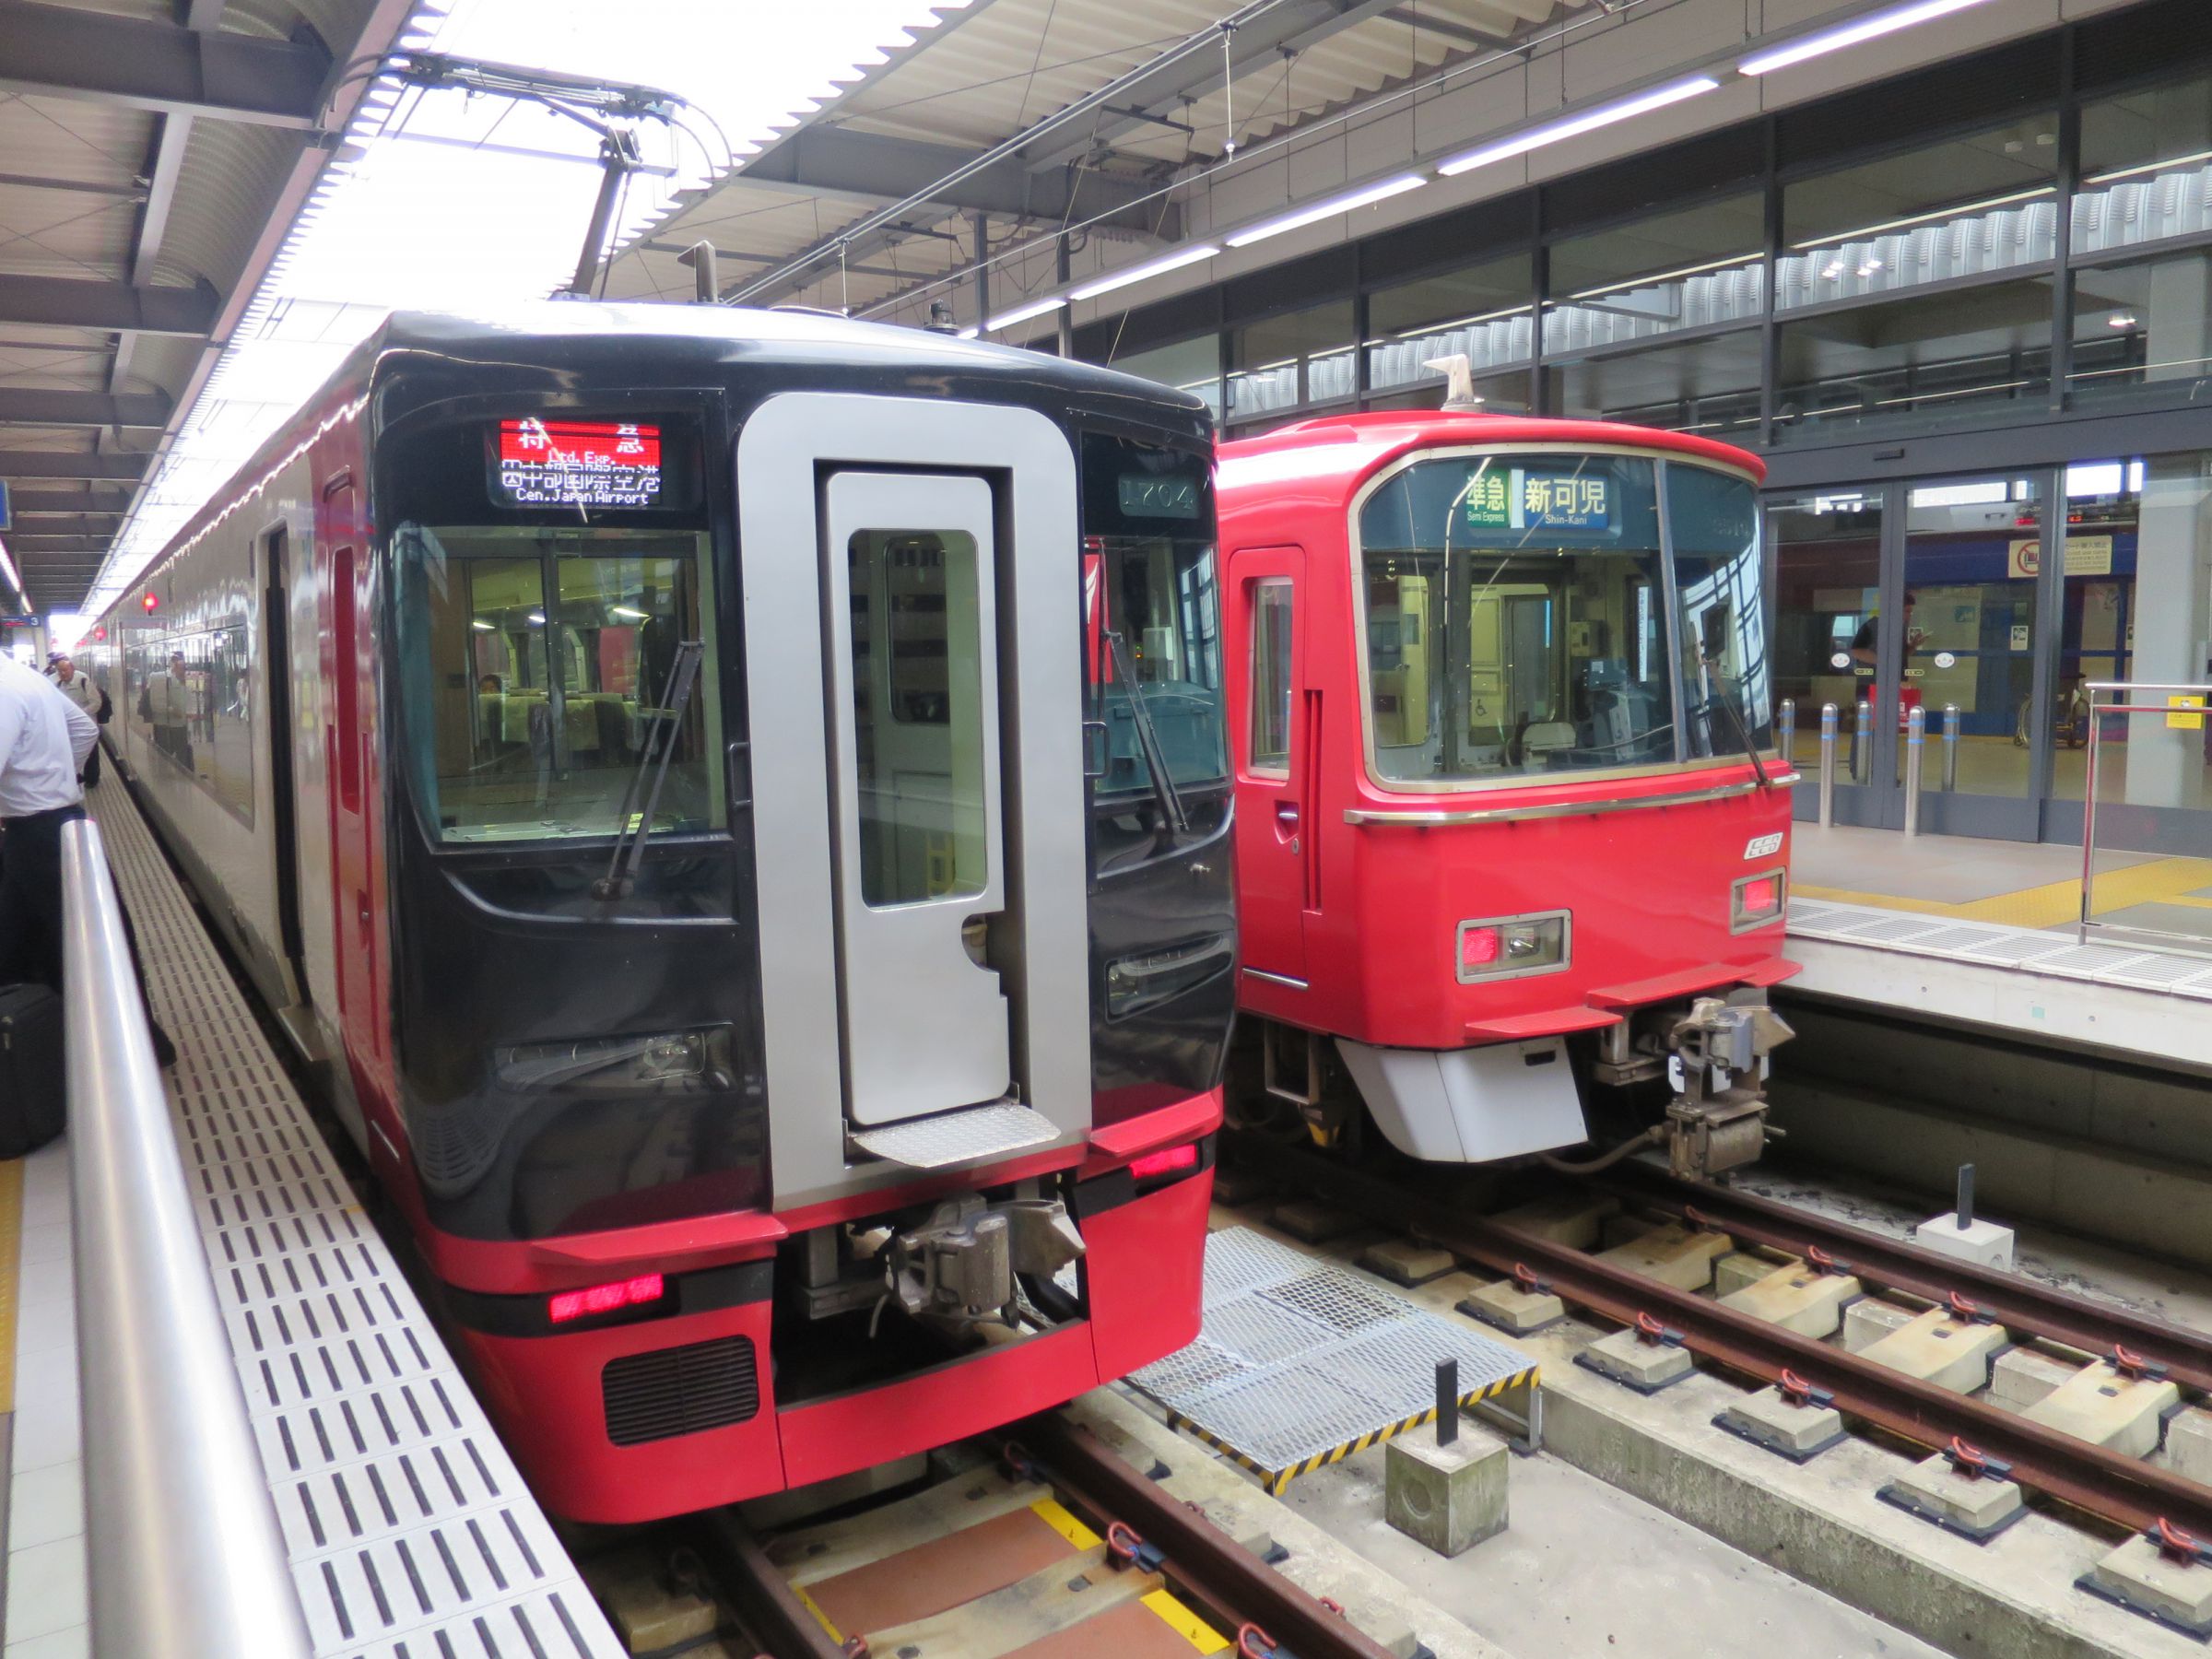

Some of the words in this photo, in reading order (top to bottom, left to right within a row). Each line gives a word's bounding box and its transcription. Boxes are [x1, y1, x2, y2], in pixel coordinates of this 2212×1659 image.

[518, 420, 644, 453] 特急
[548, 451, 580, 464] Ltd.
[584, 452, 616, 465] Exp.
[595, 490, 648, 504] Airport
[1123, 480, 1193, 509] 1704
[1466, 476, 1505, 511] 準急
[1525, 477, 1606, 514] 新可児
[1467, 511, 1482, 522] Semi
[1483, 512, 1504, 523] Express
[1545, 514, 1587, 524] Shin-Kani
[30, 617, 39, 626] 3
